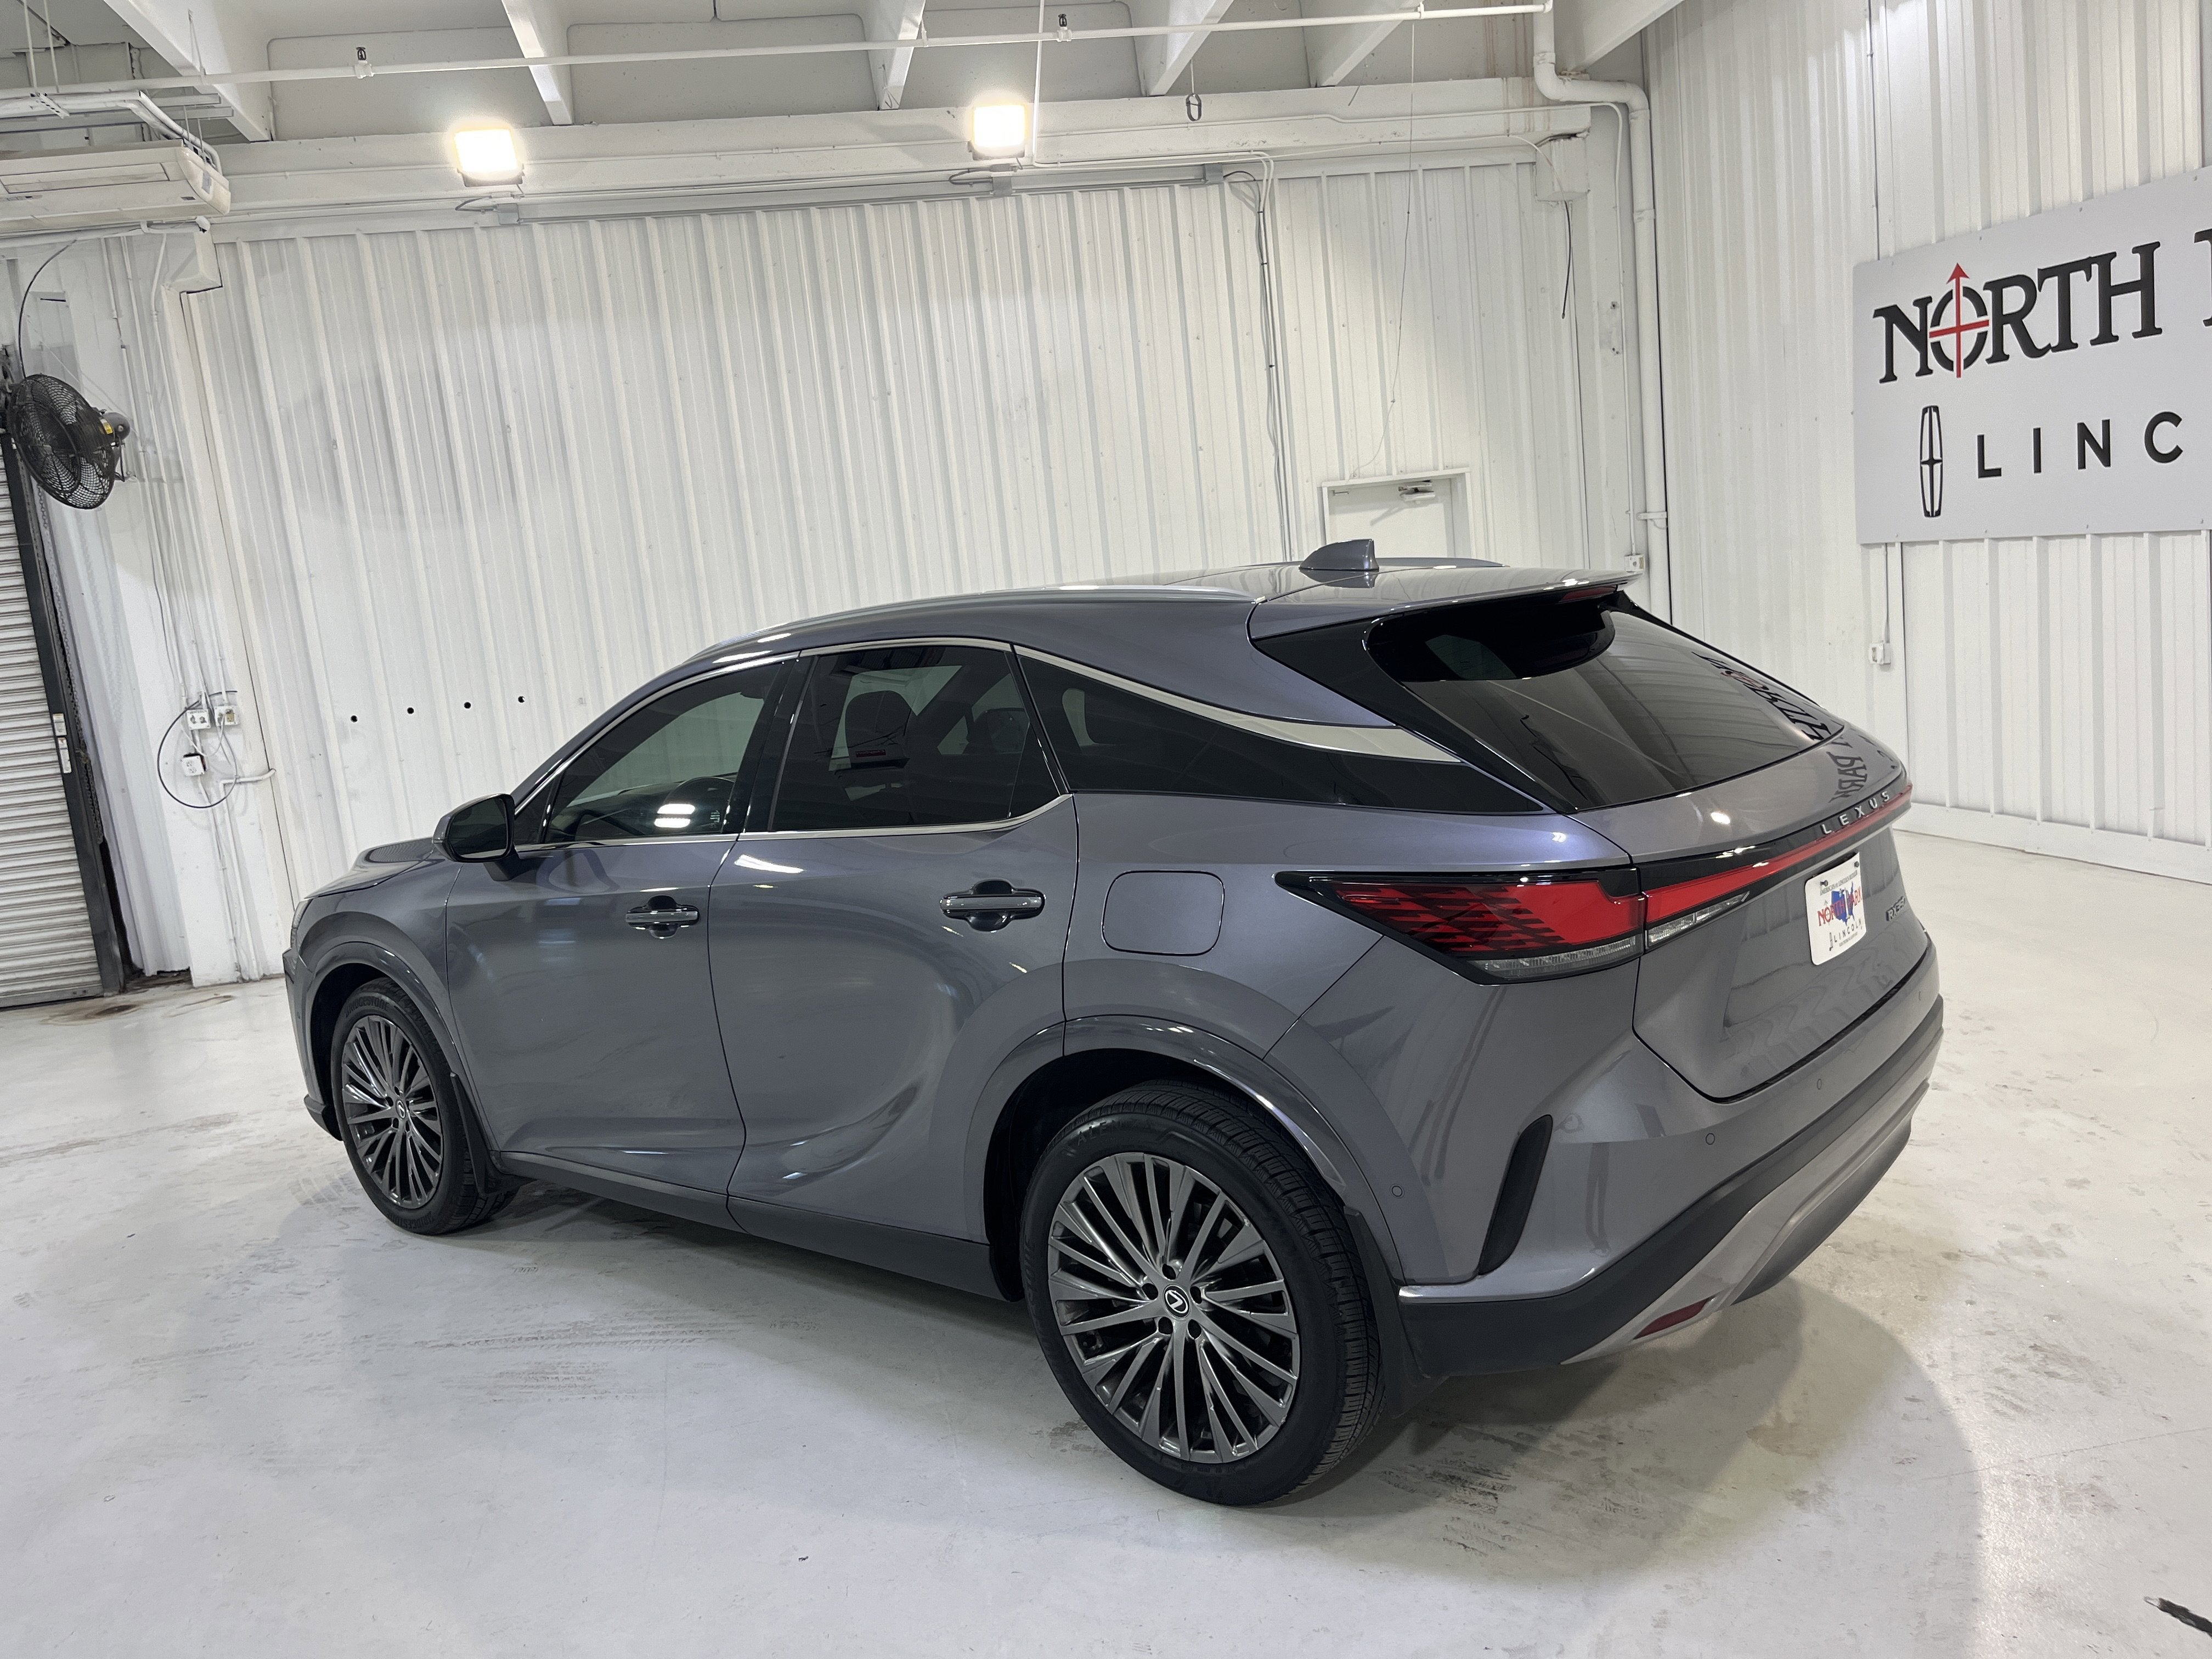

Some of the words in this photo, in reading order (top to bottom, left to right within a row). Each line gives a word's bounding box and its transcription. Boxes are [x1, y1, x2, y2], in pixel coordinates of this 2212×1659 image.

[1872, 241, 2163, 384] NORTH
[1977, 411, 2183, 479] LINC
[1821, 791, 1890, 834] LEXUS
[1817, 898, 1846, 927] NORTH
[1834, 918, 1861, 943] LINCOLN
[346, 996, 390, 1018] BRIDGESTONE
